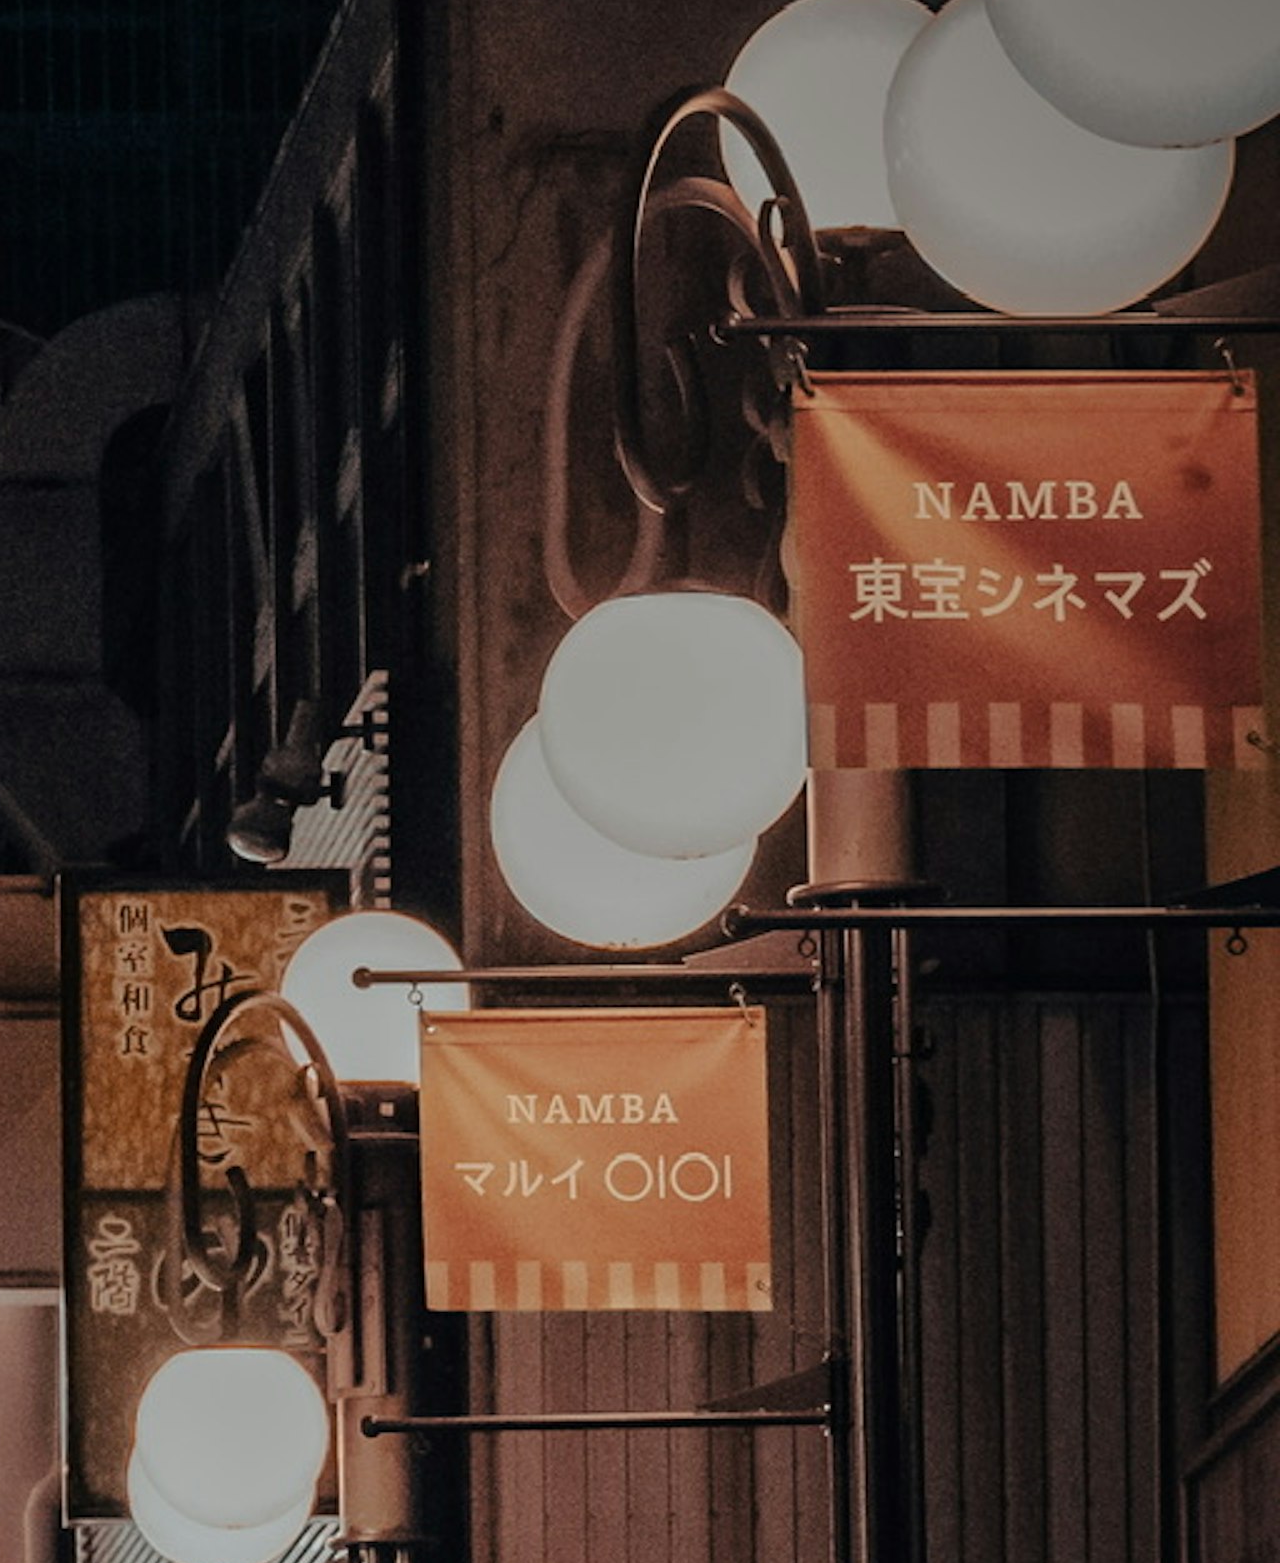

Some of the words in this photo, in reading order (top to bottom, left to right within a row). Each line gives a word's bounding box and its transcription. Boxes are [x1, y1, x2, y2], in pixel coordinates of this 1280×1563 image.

[913, 481, 1143, 521] NAMBA
[849, 557, 1213, 623] 東宝シネマズ
[118, 903, 150, 1057] 個室和食
[505, 1092, 680, 1126] NAMBA
[453, 1158, 589, 1203] マルイ
